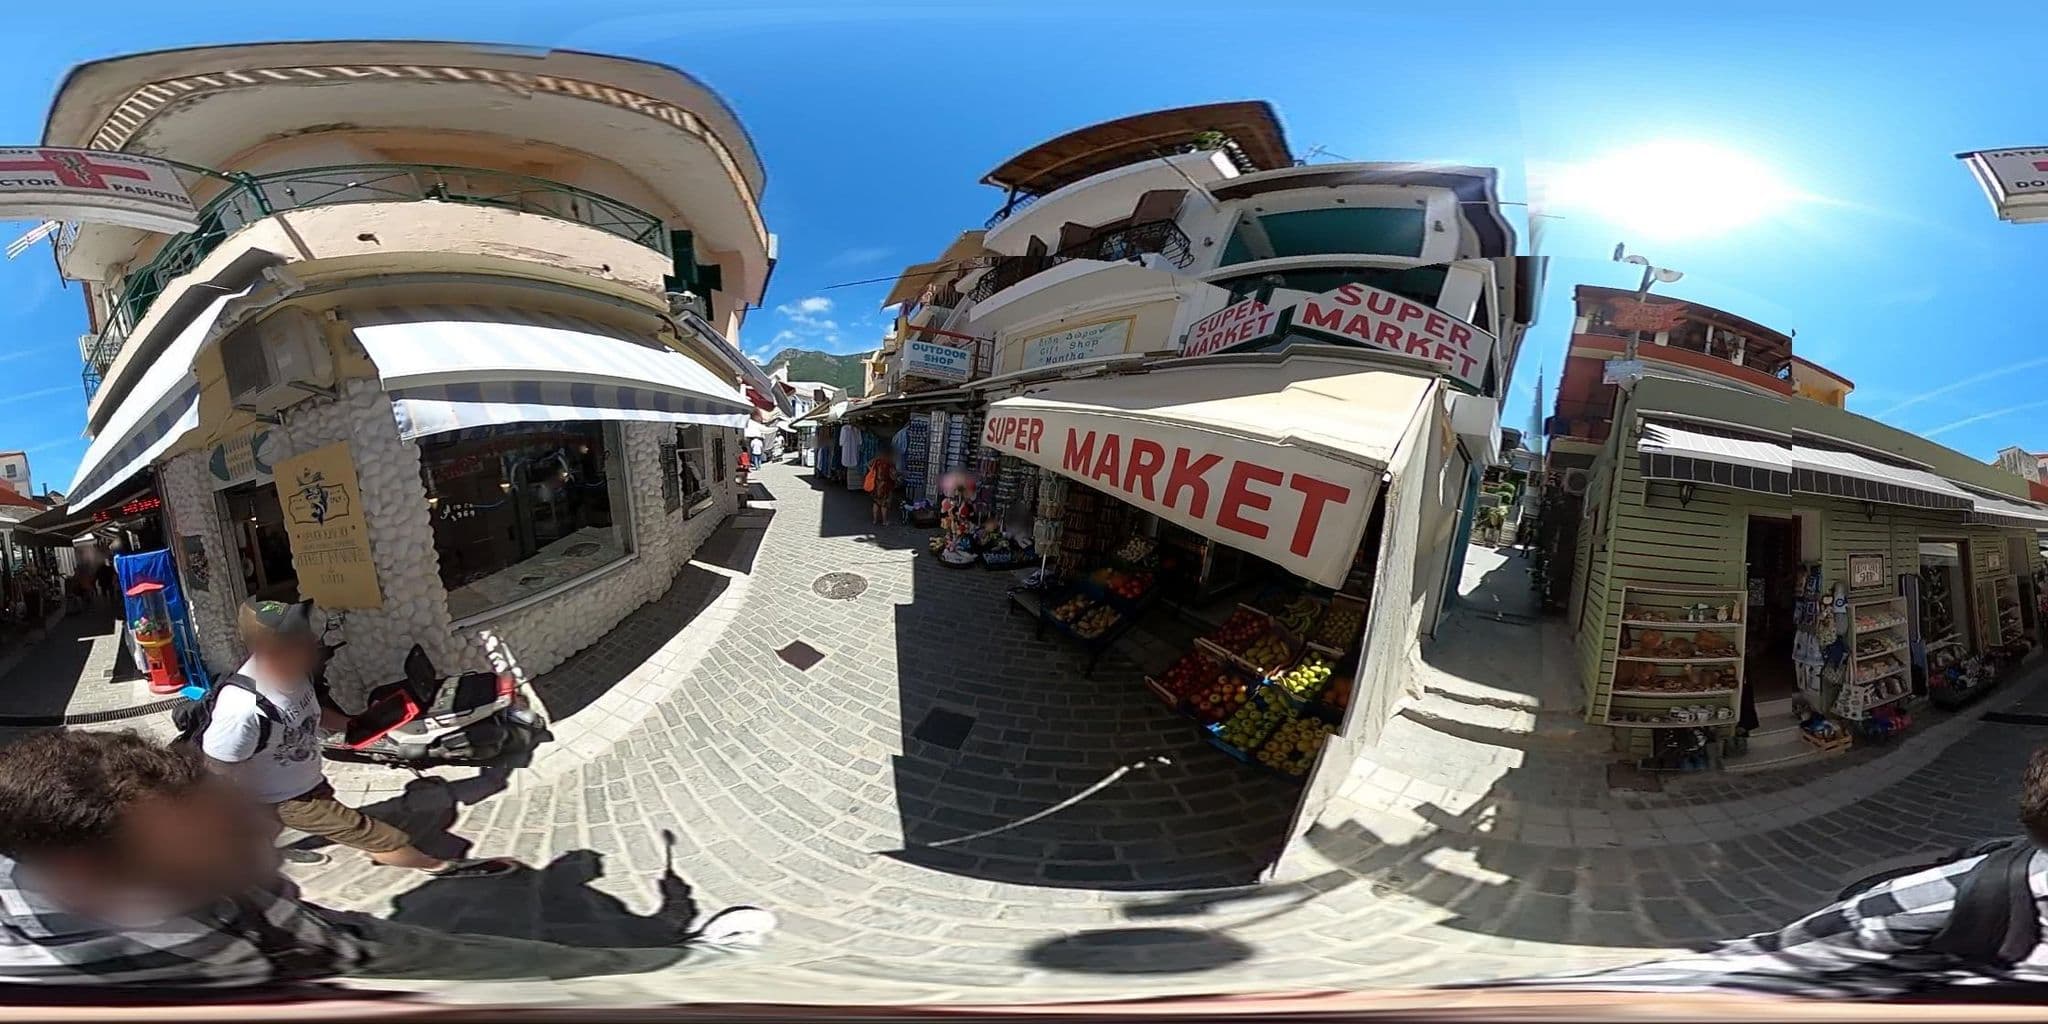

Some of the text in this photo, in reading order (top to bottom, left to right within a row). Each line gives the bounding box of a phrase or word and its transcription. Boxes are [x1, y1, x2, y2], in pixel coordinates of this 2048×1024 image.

[2015, 180, 2048, 189] DO
[1185, 311, 1276, 358] MARKET
[1196, 299, 1266, 338] SUPER
[1334, 281, 1473, 351] SUPER
[911, 342, 967, 361] OUTDOOR
[1069, 338, 1099, 351] Shop
[1302, 301, 1478, 378] MARKET
[923, 353, 954, 366] SHOP
[986, 416, 1351, 559] SUPER MARKET
